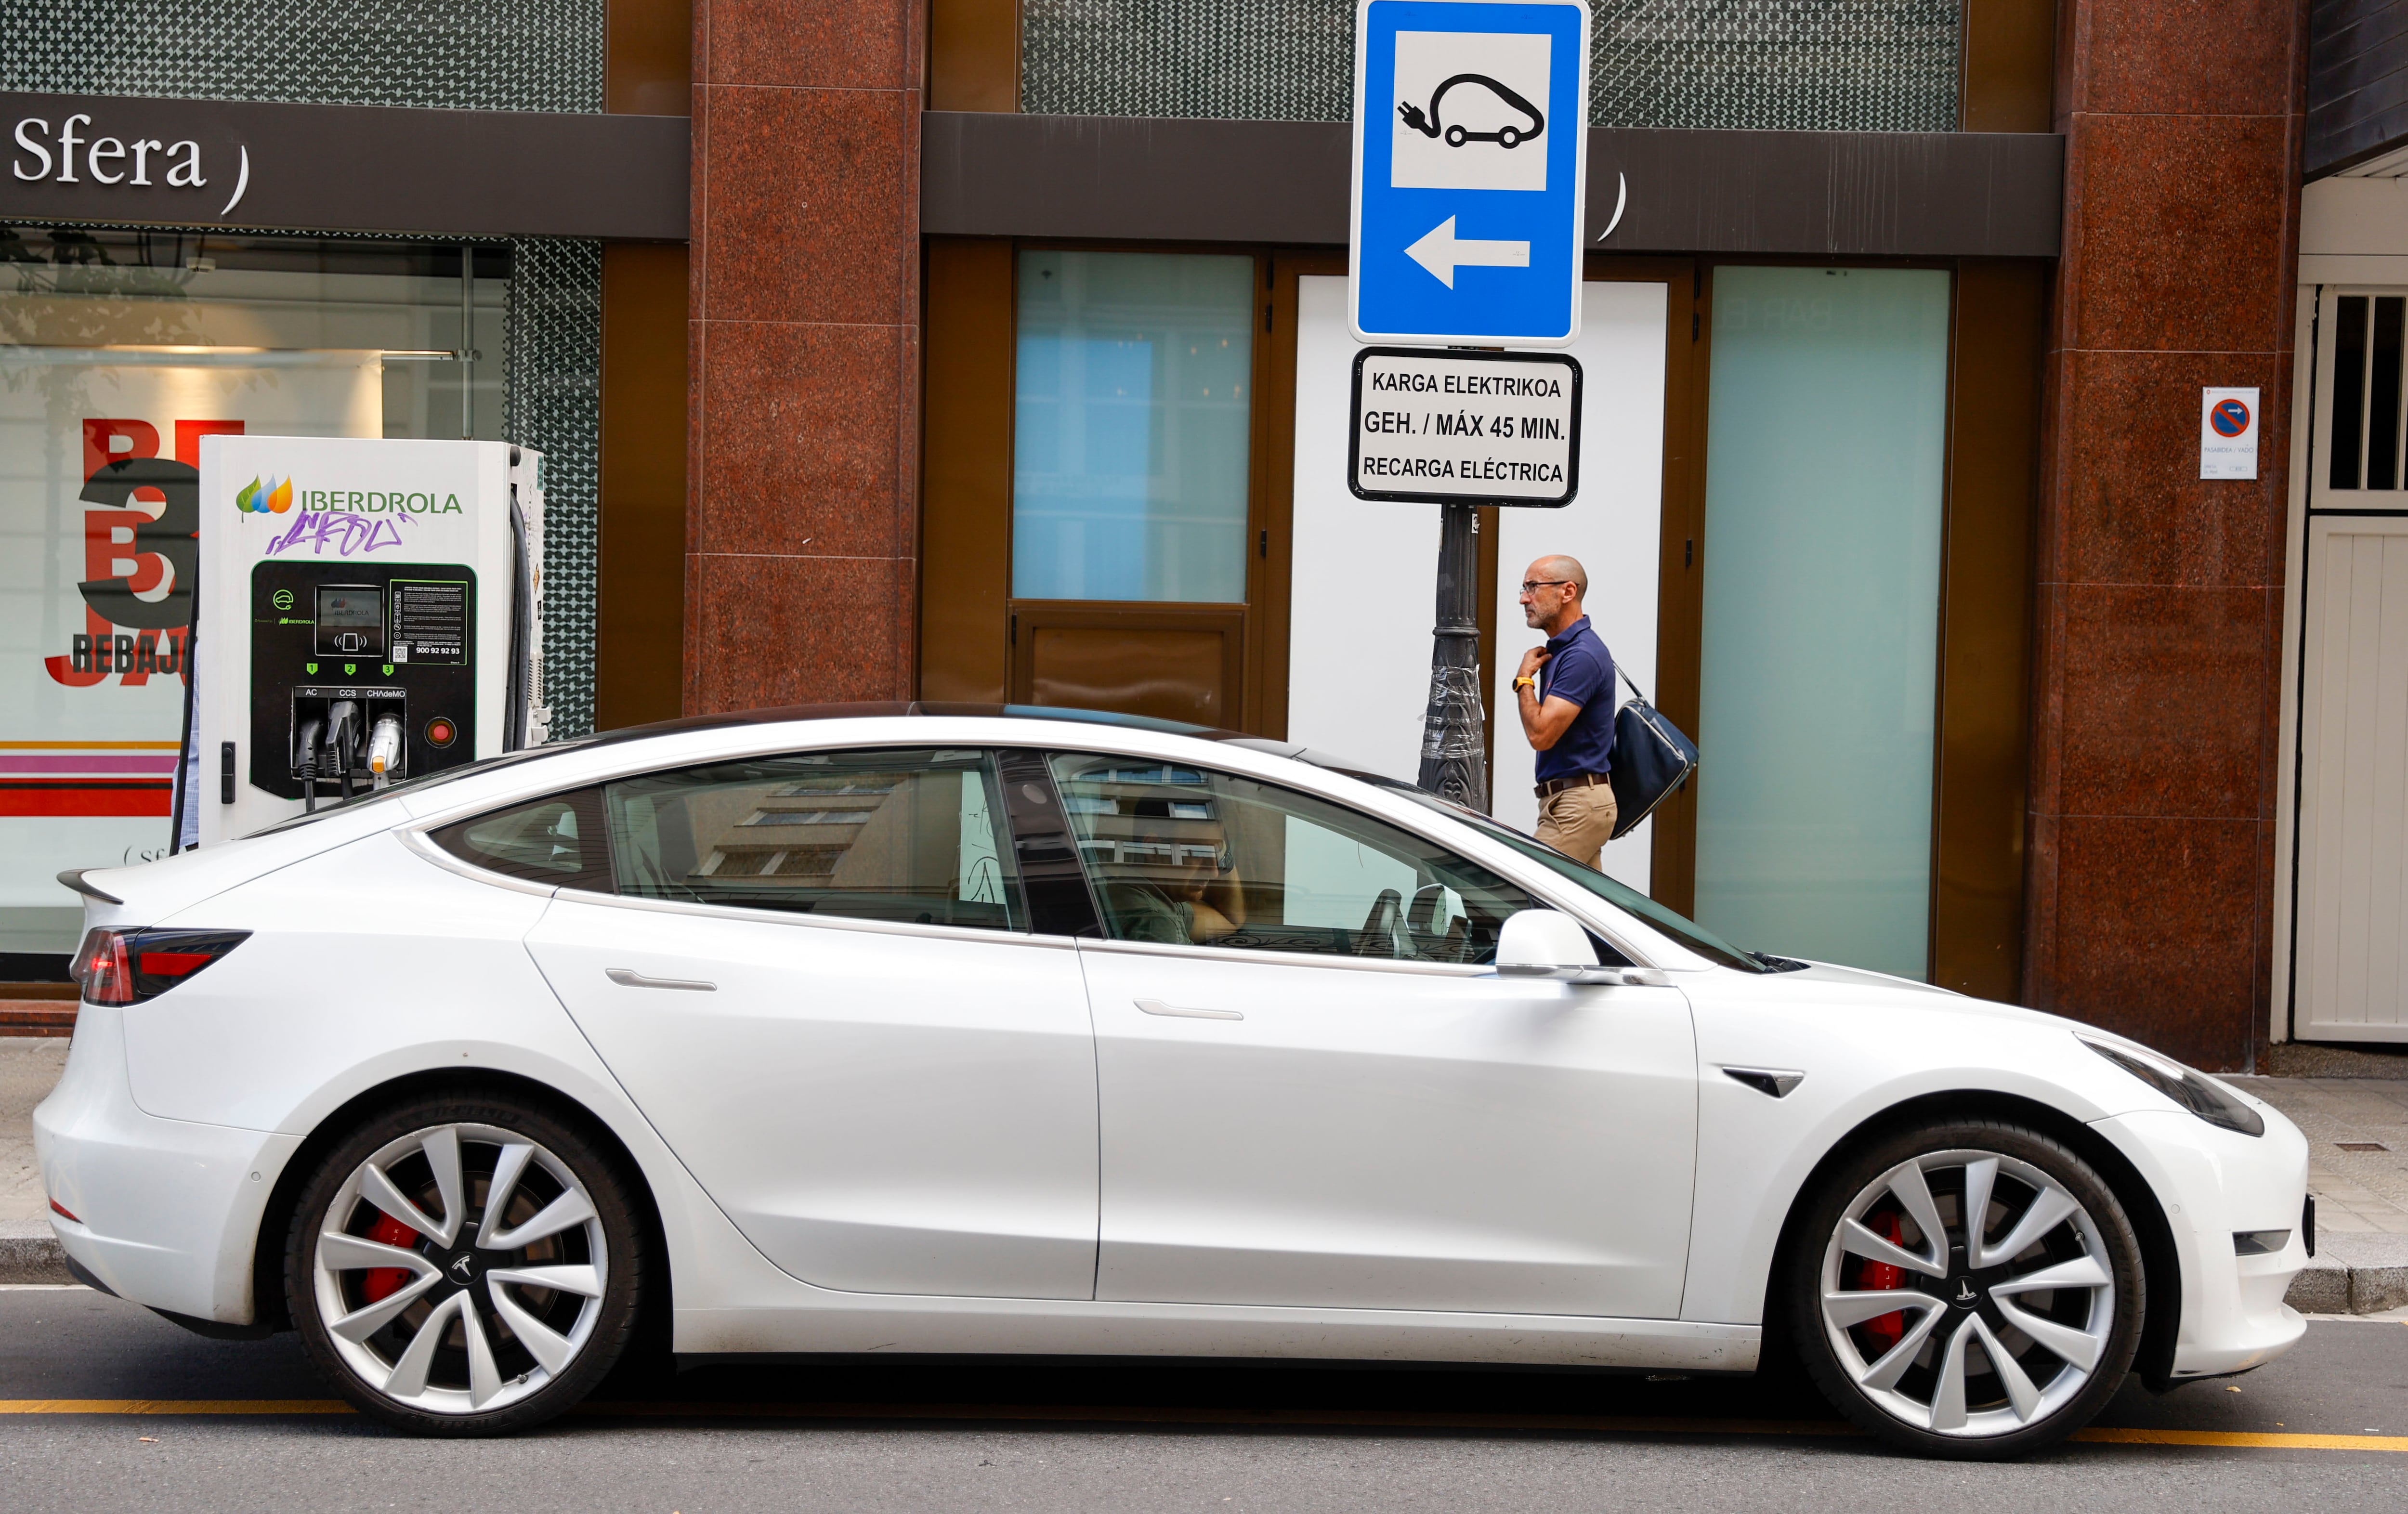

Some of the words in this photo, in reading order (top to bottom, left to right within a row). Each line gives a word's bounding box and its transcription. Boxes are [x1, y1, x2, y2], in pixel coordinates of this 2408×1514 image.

[13, 113, 207, 188] Sfera
[1373, 372, 1438, 392] KARGA
[1444, 375, 1561, 398] ELEKTRIKOA
[1364, 411, 1416, 434] GEH.
[1423, 413, 1430, 435] /
[1436, 409, 1484, 437] MÁX
[1490, 416, 1514, 438] 45
[1521, 417, 1565, 440] MIN.
[1364, 457, 1454, 478] RECARGA
[1461, 457, 1563, 482] ELÉCTRICA
[302, 490, 463, 514] IBERDROLA
[73, 634, 188, 674] REBAJ
